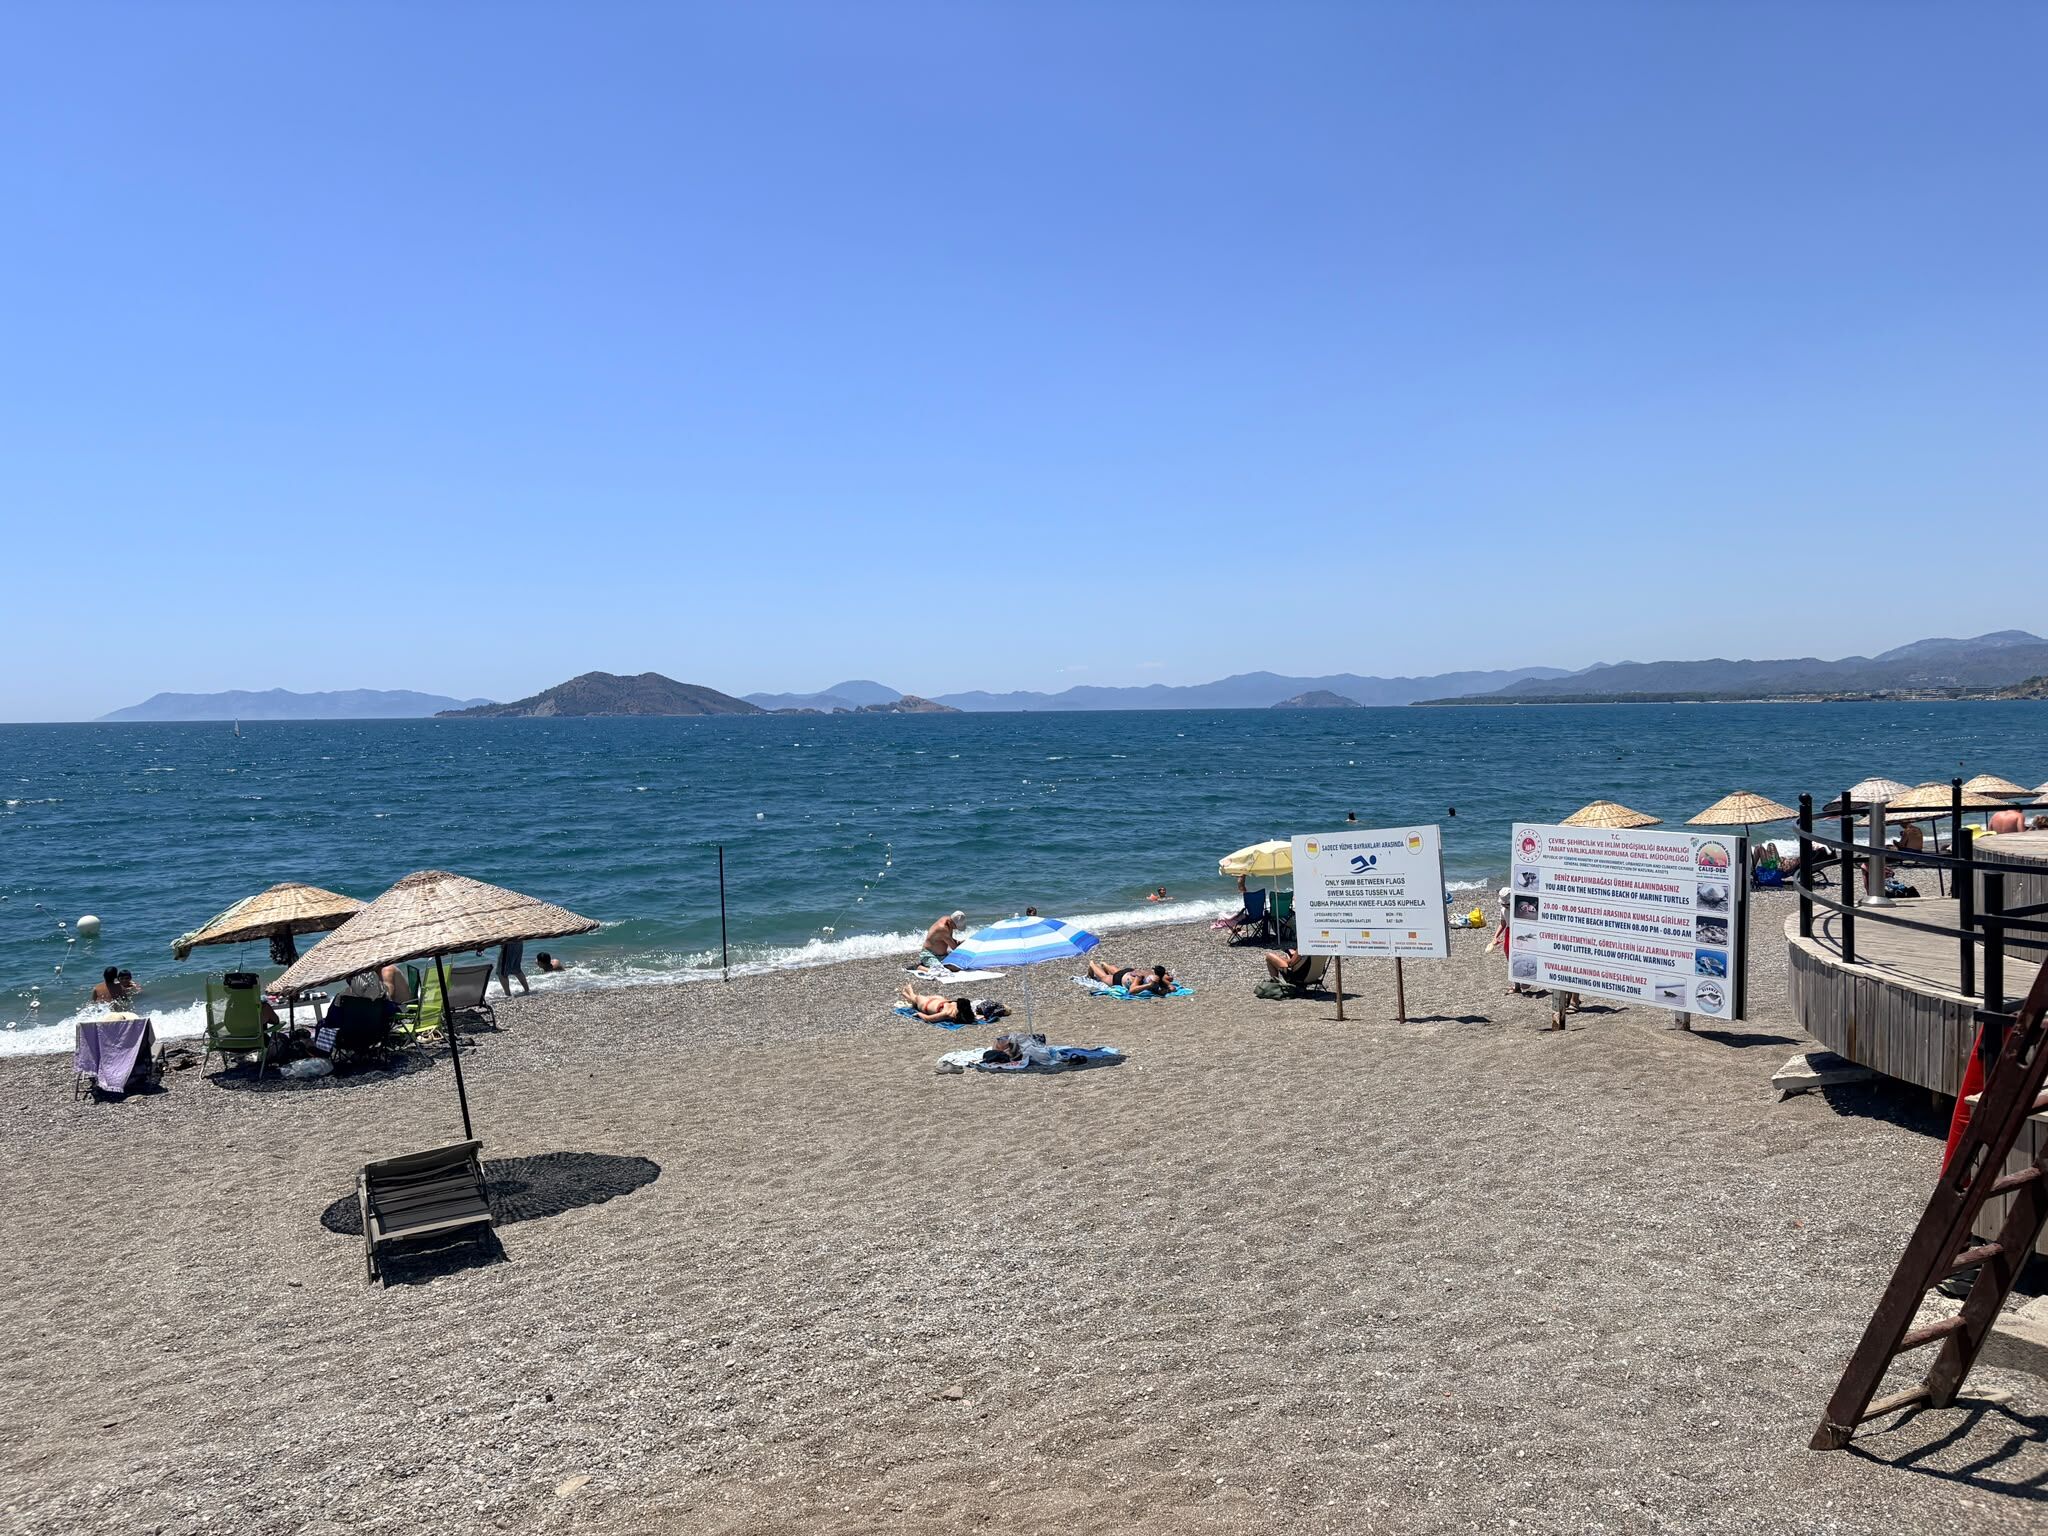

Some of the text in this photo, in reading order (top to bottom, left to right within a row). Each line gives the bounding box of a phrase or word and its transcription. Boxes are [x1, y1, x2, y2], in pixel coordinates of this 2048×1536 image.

[1650, 854, 1689, 862] MÜDÜRLÜĞÜ
[1656, 845, 1689, 853] BAKANLIĞI
[1554, 873, 1680, 893] DENİZ KAPLUMBAĞASI ÜREME ALANINDASINIZ
[1587, 887, 1611, 896] NESTING
[1612, 890, 1629, 898] BEACH
[1639, 893, 1662, 902] MARINE
[1664, 895, 1690, 905] TURTLES
[1550, 913, 1566, 922] ENTRY
[1575, 916, 1585, 924] THE
[1586, 918, 1603, 927] BEACH
[1605, 919, 1631, 930] BETWEEN
[1632, 924, 1648, 932] 08.00
[1663, 928, 1680, 936] 08.00
[1562, 905, 1576, 913] 08.00
[1577, 906, 1602, 916] SAATLERİ
[1603, 910, 1631, 919] ARASINDA
[1633, 913, 1660, 923] KUMSALA
[1661, 915, 1690, 926] GİRİLMEZ
[1539, 932, 1558, 940] ÇEVREYİ
[1559, 933, 1597, 946] KİRLETMEYİNİZ,
[1599, 939, 1635, 952] GÖREVLİLERİN
[1670, 950, 1693, 959] UYUNUZ
[1573, 946, 1593, 955] LITTER,
[1594, 949, 1616, 958] FOLLOW
[1617, 952, 1642, 962] OFFICIAL
[1643, 956, 1675, 967] WARNINGS
[1544, 962, 1647, 985] YUVALAMA ALANINDA GÜNEŞLENİLMEZ
[1558, 974, 1591, 986] SUNBATHING
[1602, 983, 1625, 993] NESTING
[1626, 986, 1641, 995] ZONE
